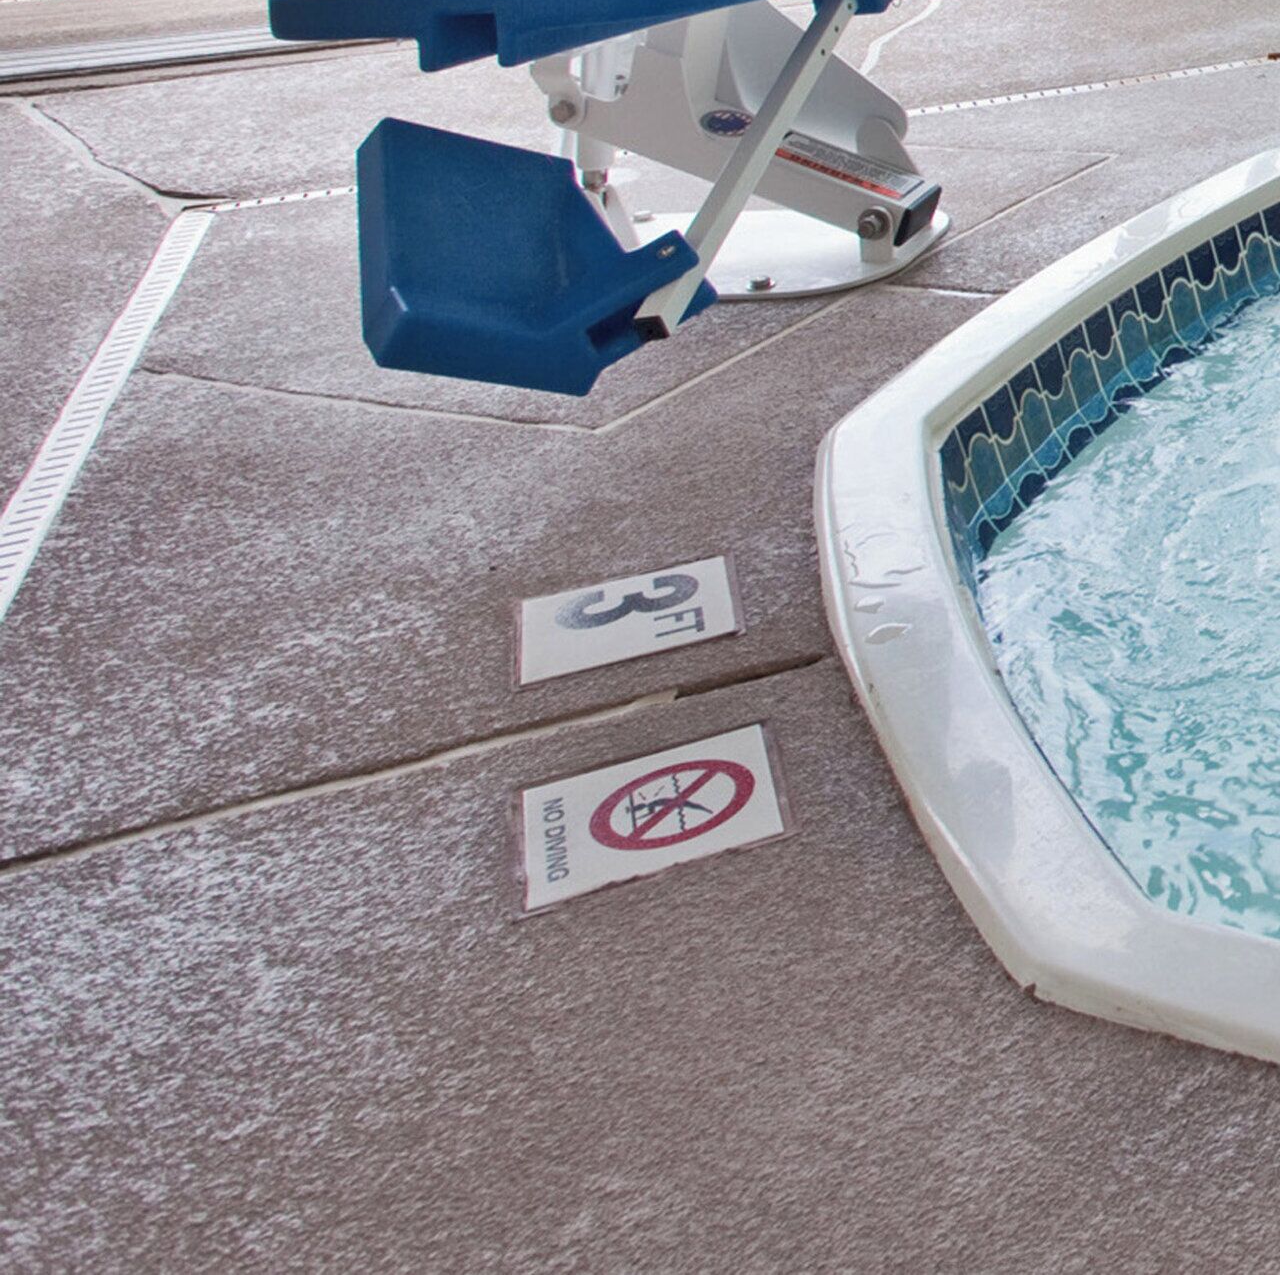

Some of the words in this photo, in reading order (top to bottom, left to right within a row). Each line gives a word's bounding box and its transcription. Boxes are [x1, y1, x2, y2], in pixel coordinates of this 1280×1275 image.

[554, 573, 699, 630] 3
[653, 606, 705, 638] FT
[543, 797, 565, 823] NO
[545, 825, 570, 882] DIVING
